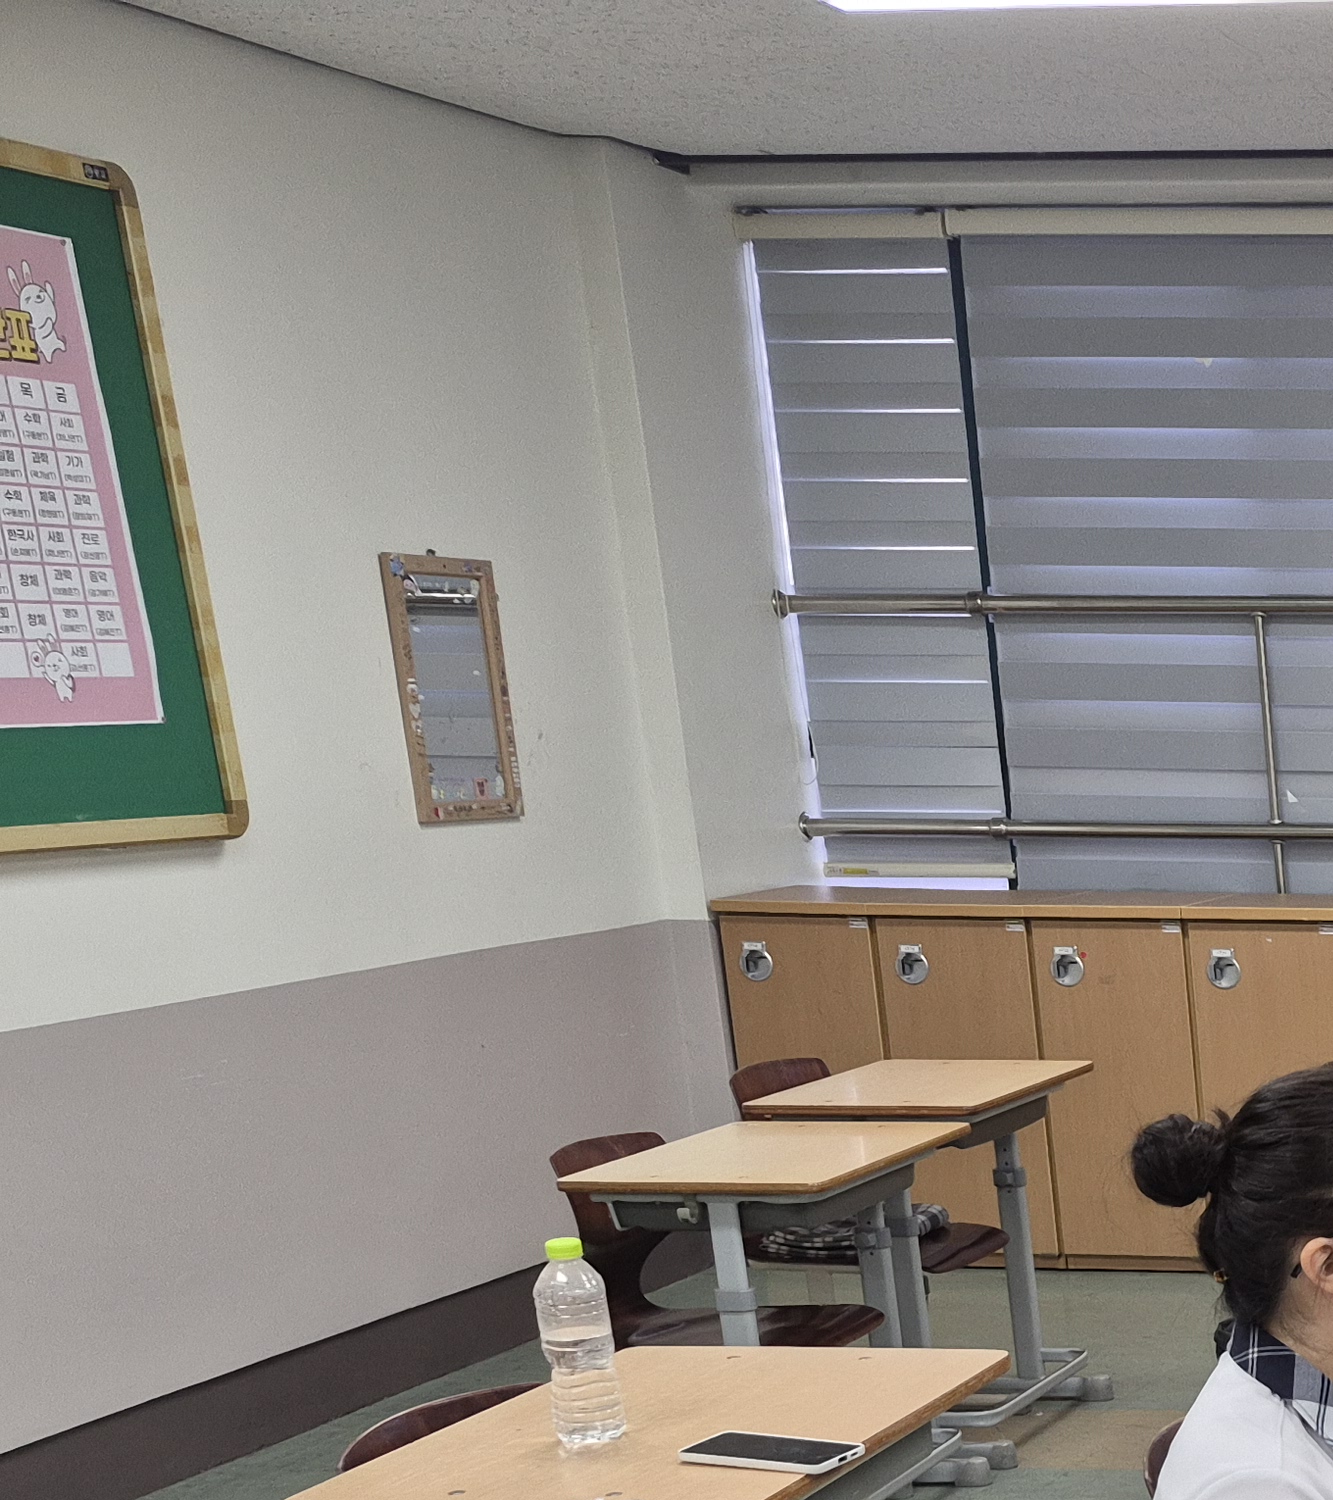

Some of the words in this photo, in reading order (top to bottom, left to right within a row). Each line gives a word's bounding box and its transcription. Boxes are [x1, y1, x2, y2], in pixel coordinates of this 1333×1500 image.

[20, 382, 34, 398] 목
[55, 386, 67, 403] 금
[24, 412, 41, 425] 수학
[32, 452, 49, 464] 과학
[65, 456, 83, 468] 기가
[4, 489, 23, 502] 수학
[73, 494, 91, 506] 과학
[7, 529, 35, 541] 한국사
[48, 531, 65, 542] 사회
[81, 533, 100, 545] 진로
[19, 573, 39, 587] 창체
[54, 569, 72, 581] 과학
[89, 571, 107, 582] 음악
[27, 614, 47, 627] 창체
[71, 646, 88, 657] 사회
